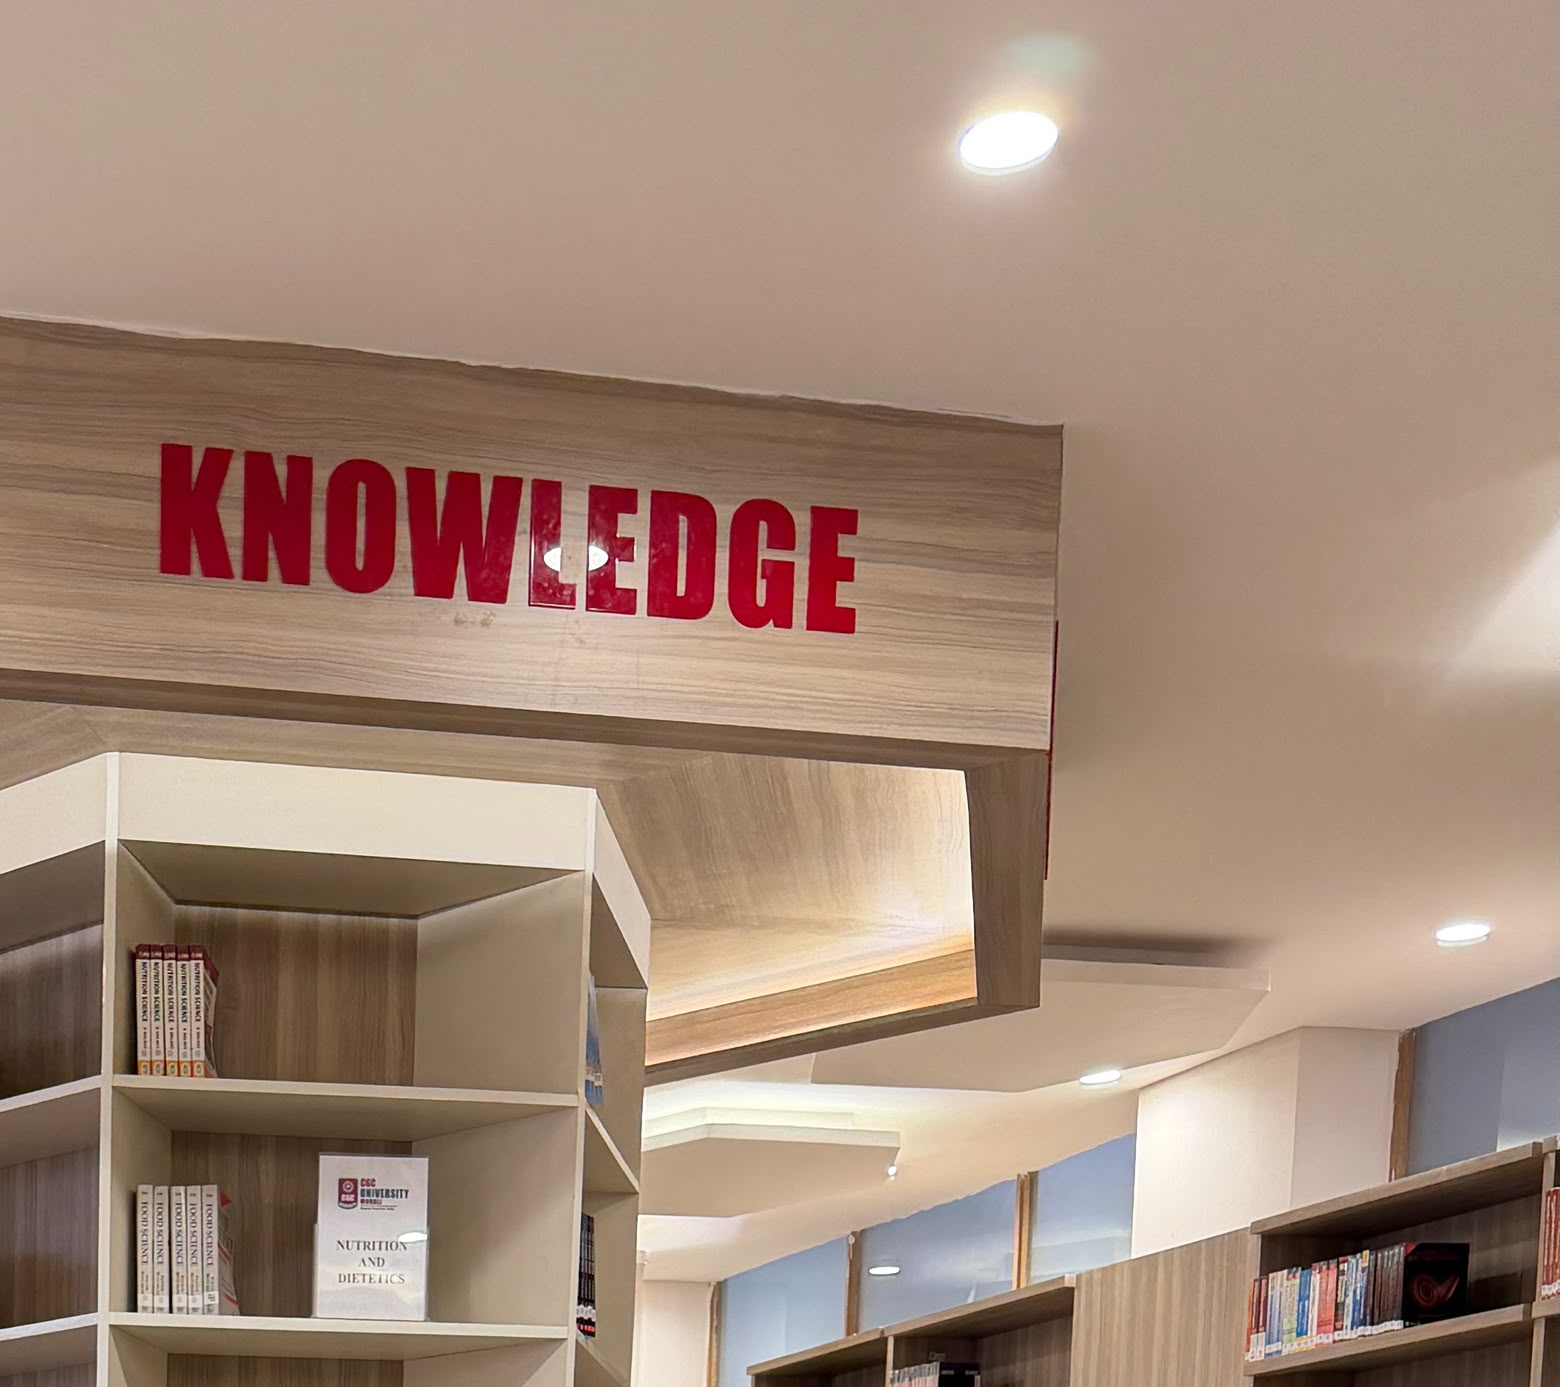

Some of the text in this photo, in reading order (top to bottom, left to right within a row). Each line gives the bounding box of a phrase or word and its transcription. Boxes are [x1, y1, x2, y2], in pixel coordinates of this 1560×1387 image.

[157, 444, 859, 635] KNOWLEDGE
[360, 1189, 409, 1199] UNIVERSITY
[336, 1240, 408, 1251] NUTRITION
[359, 1257, 385, 1267] AND
[338, 1273, 405, 1285] DIETETICS
